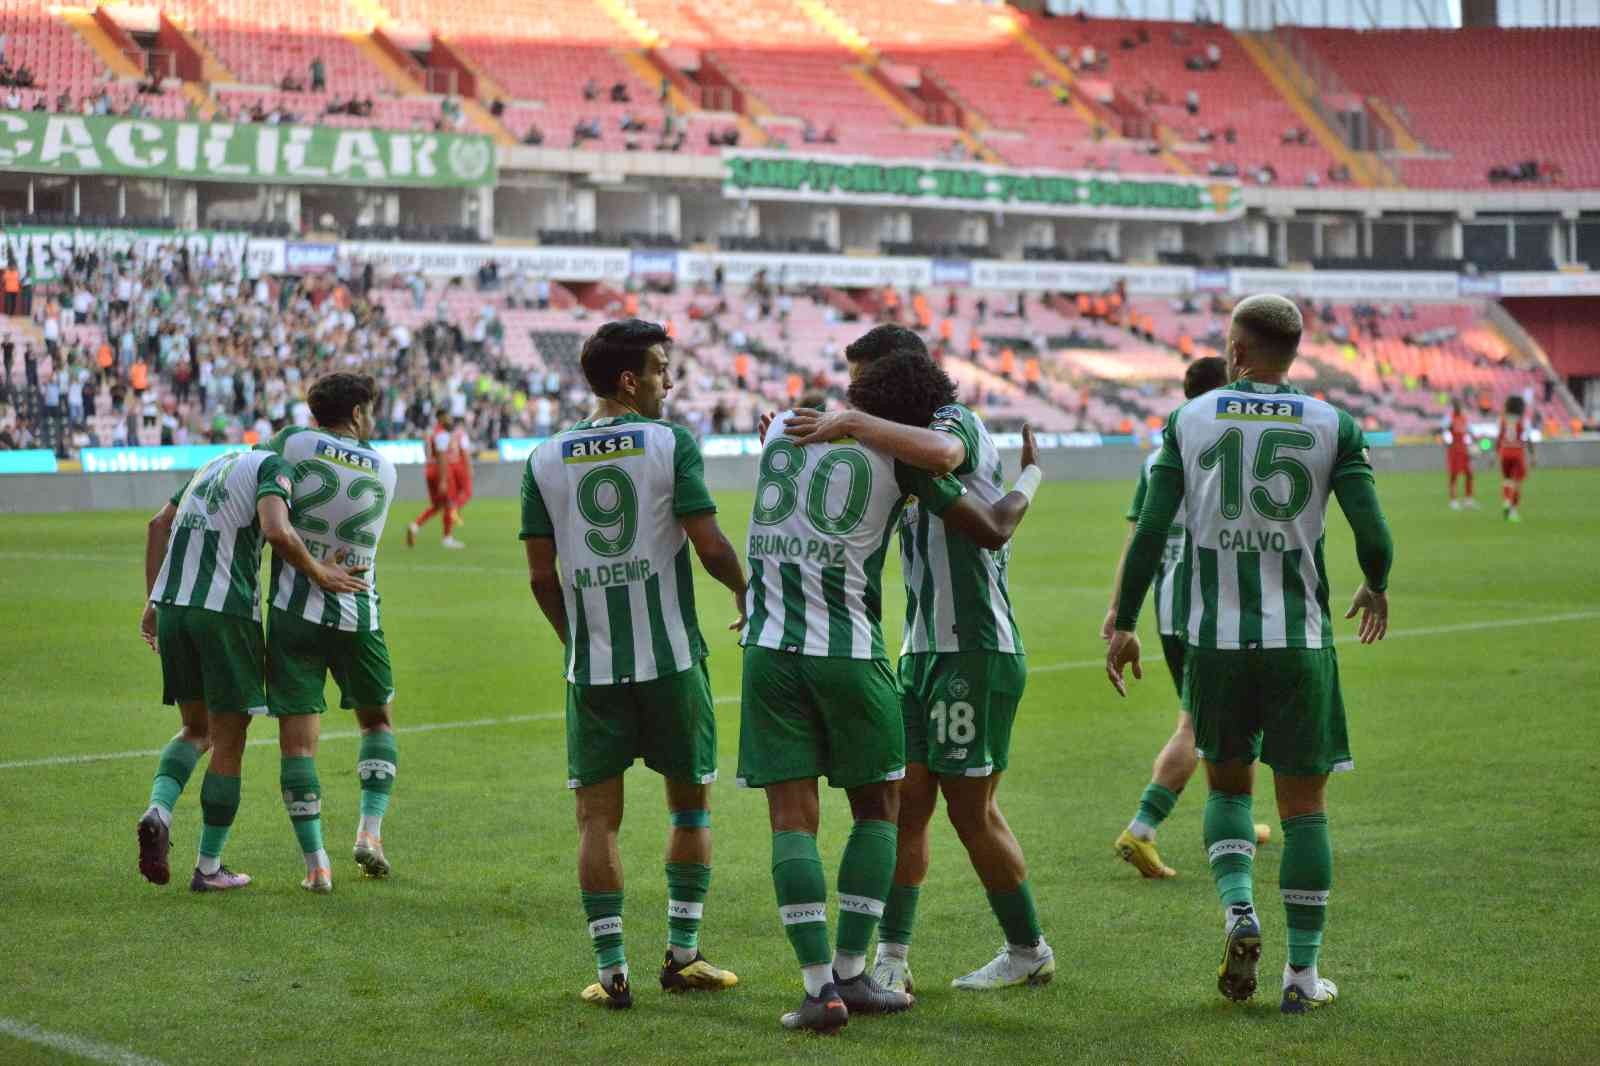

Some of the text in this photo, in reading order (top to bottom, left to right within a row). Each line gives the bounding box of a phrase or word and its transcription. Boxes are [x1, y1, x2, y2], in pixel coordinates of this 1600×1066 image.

[1226, 400, 1293, 417] aksa
[323, 444, 374, 472] aksa
[571, 434, 635, 458] aksa
[751, 438, 873, 536] 80
[1199, 426, 1316, 522] 15
[291, 459, 386, 548] 22
[576, 464, 639, 558] 9
[747, 534, 846, 564] BRUNO PAZ
[1218, 529, 1286, 552] CALVO
[573, 556, 651, 589] M.DEMİR
[930, 701, 976, 745] 18
